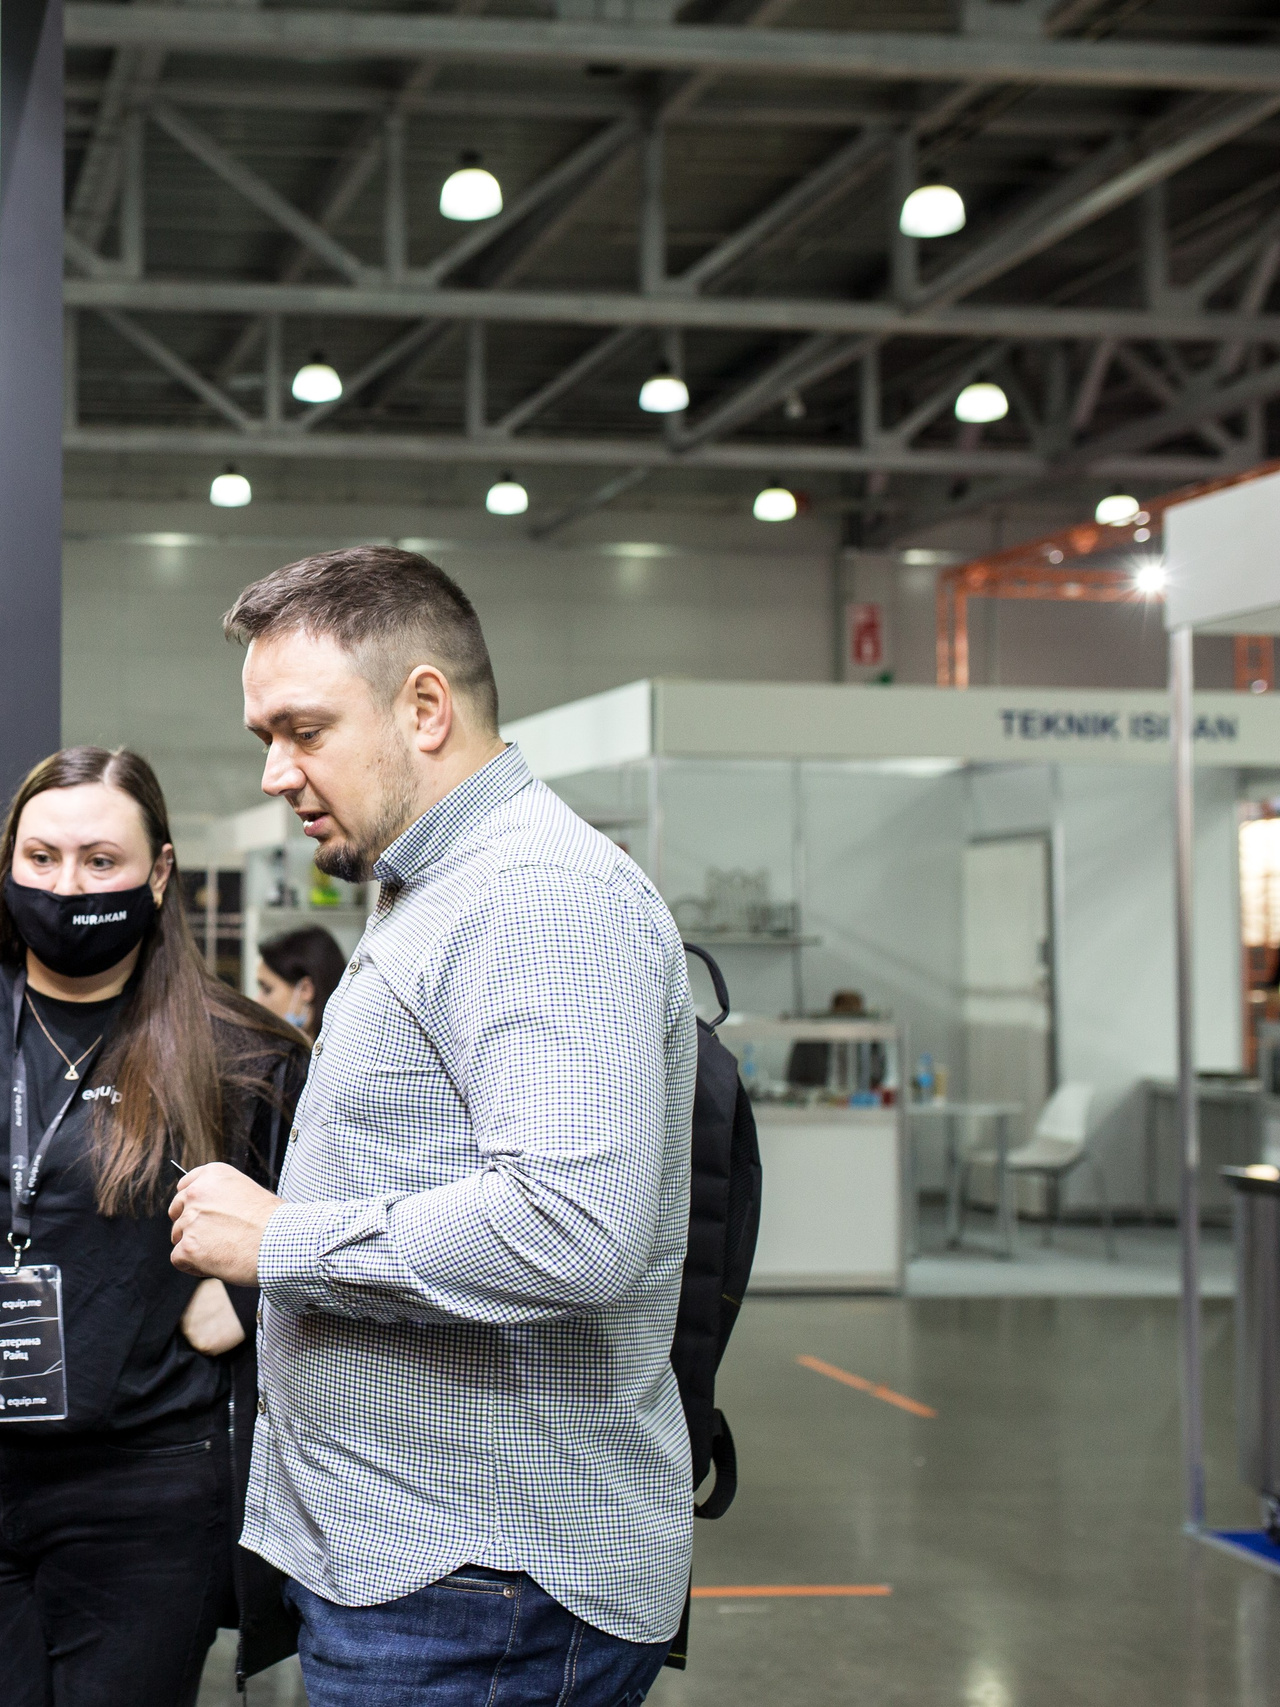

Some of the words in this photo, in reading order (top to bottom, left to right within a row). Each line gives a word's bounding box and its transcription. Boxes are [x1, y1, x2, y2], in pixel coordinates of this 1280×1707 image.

[1000, 709, 1120, 741] TEKNIK
[1128, 710, 1238, 742] ISIAN
[72, 910, 127, 925] HURAKAN
[2, 1298, 42, 1310] equip.me
[7, 1396, 47, 1407] equip.me
